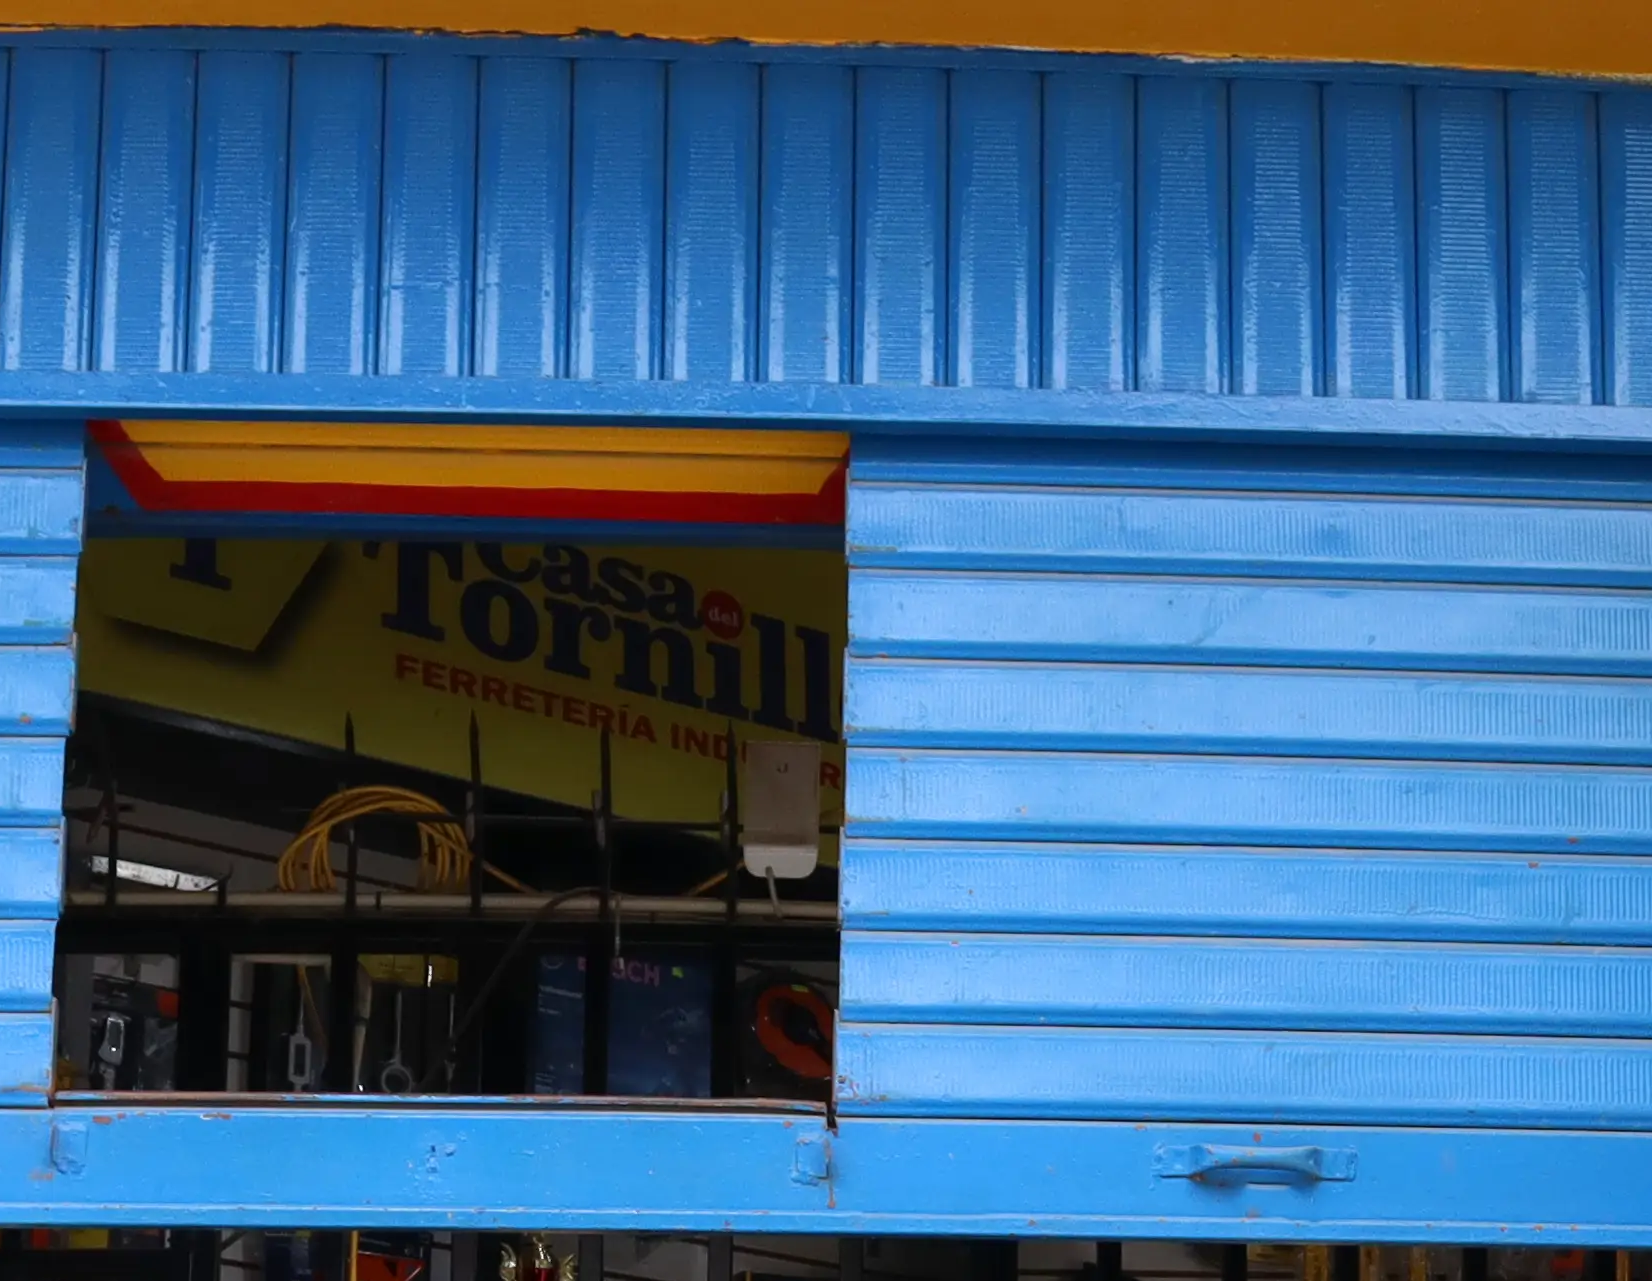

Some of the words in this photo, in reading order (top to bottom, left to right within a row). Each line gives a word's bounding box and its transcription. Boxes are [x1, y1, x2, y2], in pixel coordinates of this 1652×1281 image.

[708, 605, 739, 631] del
[395, 654, 657, 744] FERRETERÍA
[577, 956, 661, 988] BSCH
